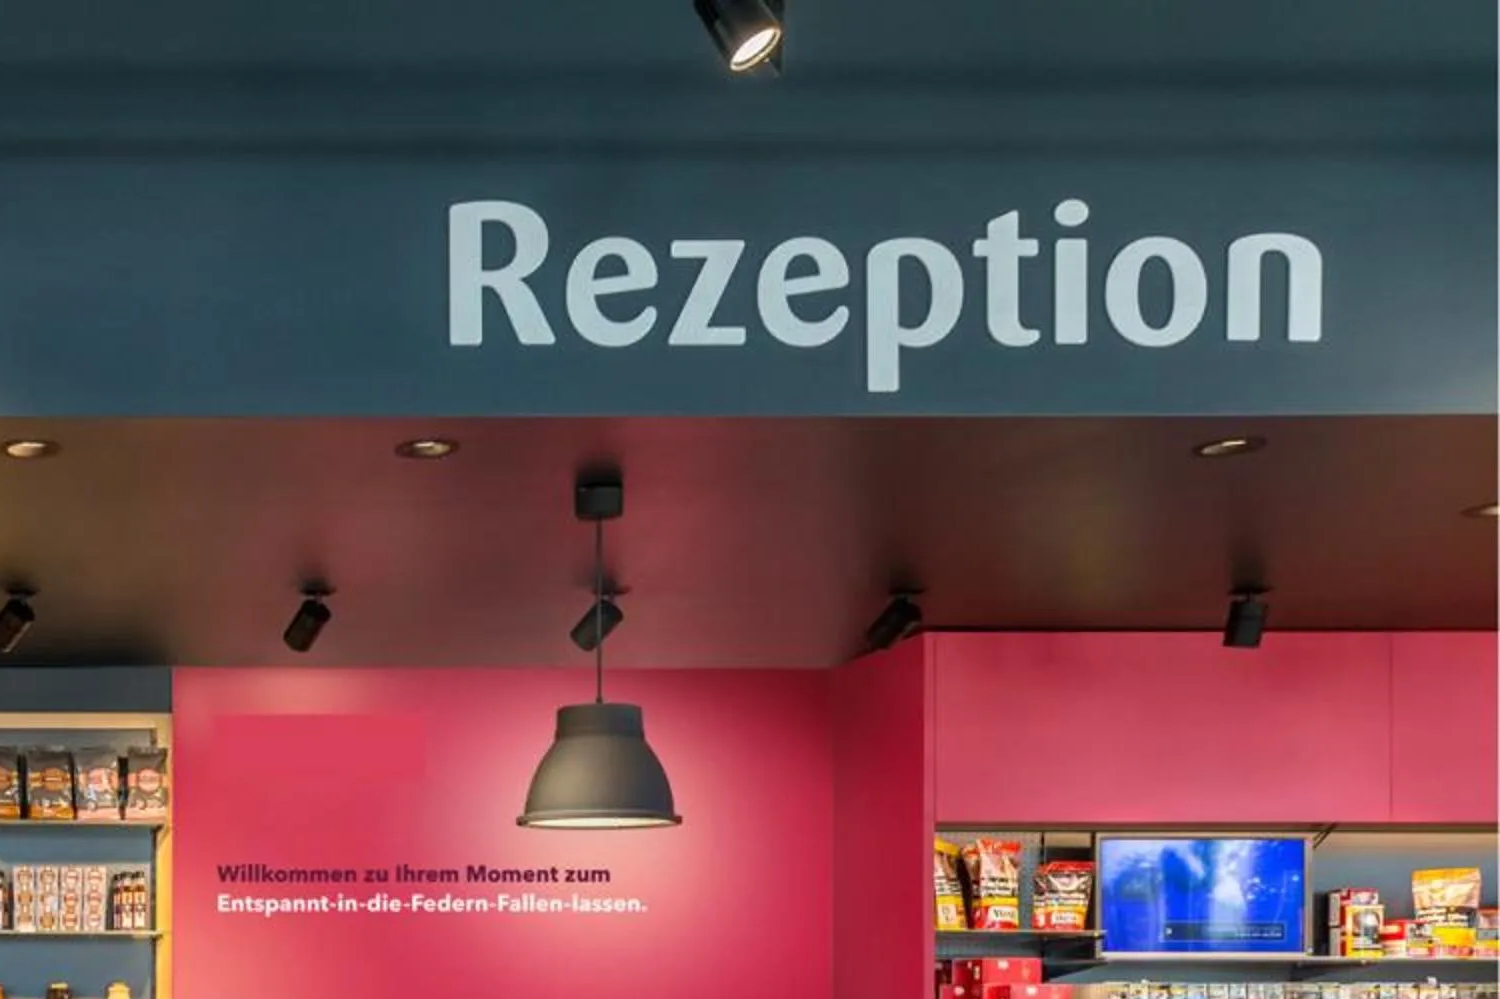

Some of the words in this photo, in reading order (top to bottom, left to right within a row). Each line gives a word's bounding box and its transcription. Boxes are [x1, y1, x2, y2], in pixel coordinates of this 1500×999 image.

[448, 199, 1324, 393] Rezeption
[217, 864, 357, 883] Willkommen
[363, 869, 390, 883] zu
[396, 864, 460, 883] Ihrem
[466, 864, 559, 883] Moment
[565, 869, 611, 883] zum
[217, 892, 648, 917] Entspannt-in-die-Federn-Fallen-lassen.
